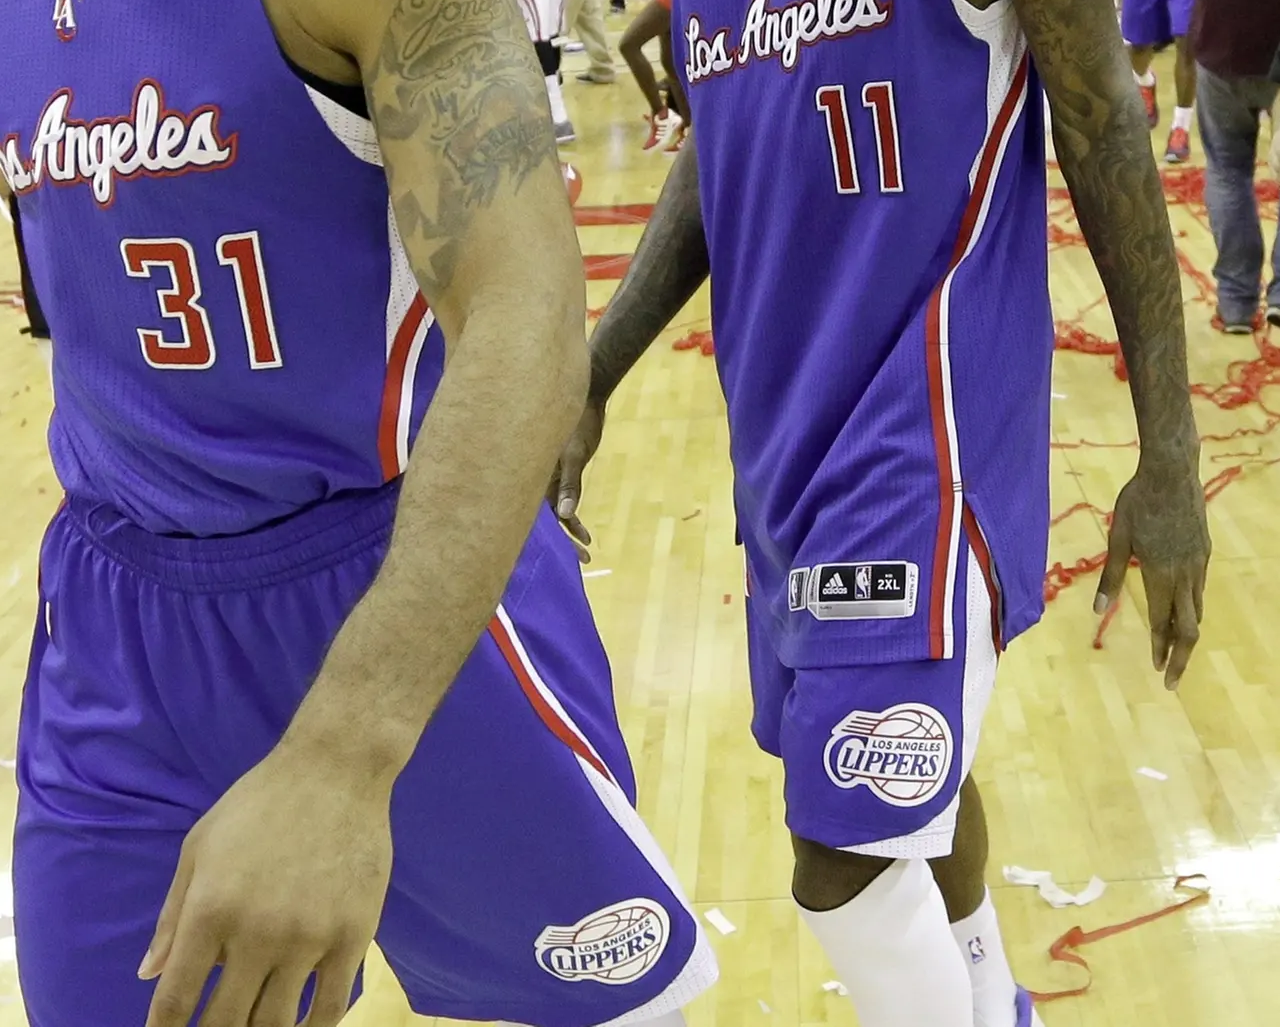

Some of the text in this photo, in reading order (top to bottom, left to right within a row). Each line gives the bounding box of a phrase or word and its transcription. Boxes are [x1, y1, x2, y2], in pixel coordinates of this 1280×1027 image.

[685, 15, 734, 85] Los
[30, 78, 237, 209] Angeles
[815, 81, 904, 194] 11
[120, 231, 283, 370] 31
[822, 586, 848, 595] adidas
[877, 579, 901, 591] 2XL
[829, 734, 939, 782] CLIPPERS
[872, 740, 941, 753] LOS ANGELES
[541, 926, 656, 979] CLIPPERS
[578, 917, 651, 953] LOS ANGELES
